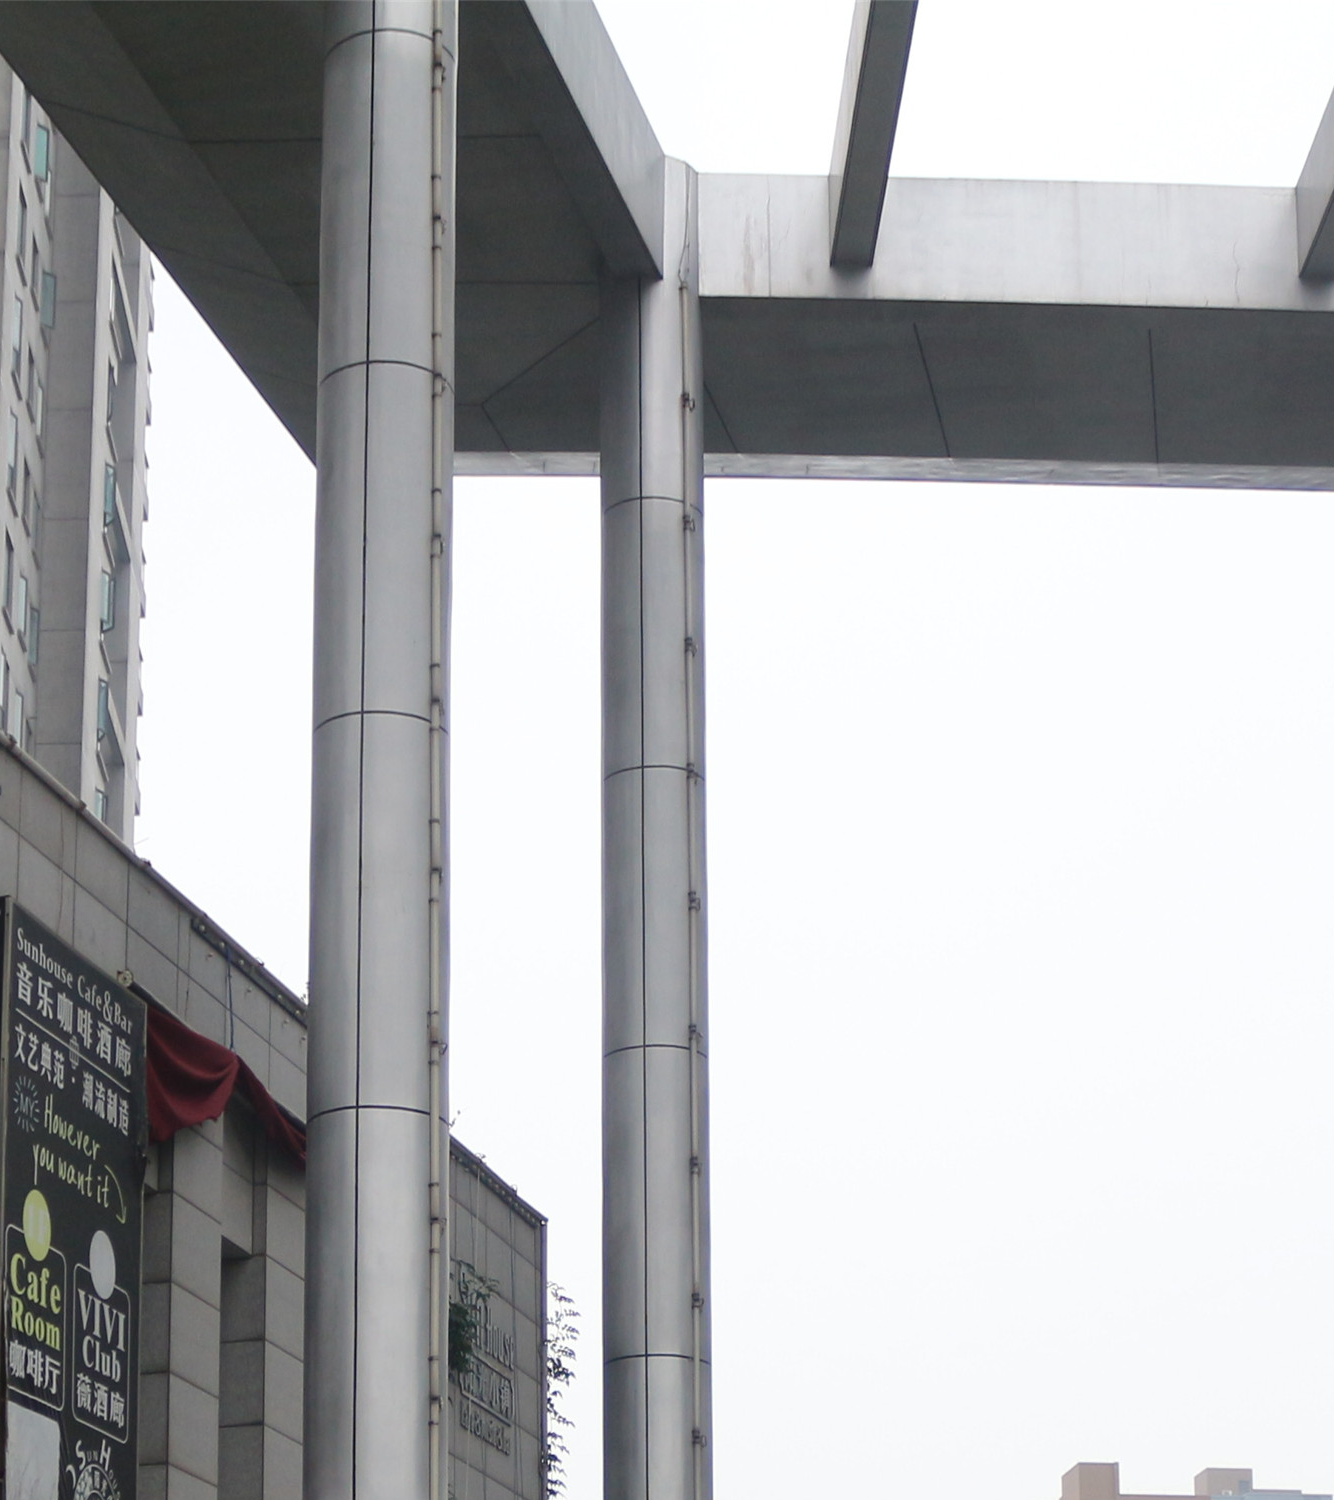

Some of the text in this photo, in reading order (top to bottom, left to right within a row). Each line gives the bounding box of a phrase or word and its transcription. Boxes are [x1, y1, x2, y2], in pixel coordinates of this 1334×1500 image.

[16, 927, 74, 989] Sunhouse
[16, 961, 133, 1078] 音乐咖啡酒廊
[43, 1093, 101, 1161] However
[32, 1142, 110, 1209] you want it
[9, 1252, 62, 1315] Cafe
[9, 1295, 61, 1351] Room
[77, 1287, 127, 1353] VIVI
[8, 1339, 62, 1395] 咖啡厅
[81, 1334, 122, 1383] Club
